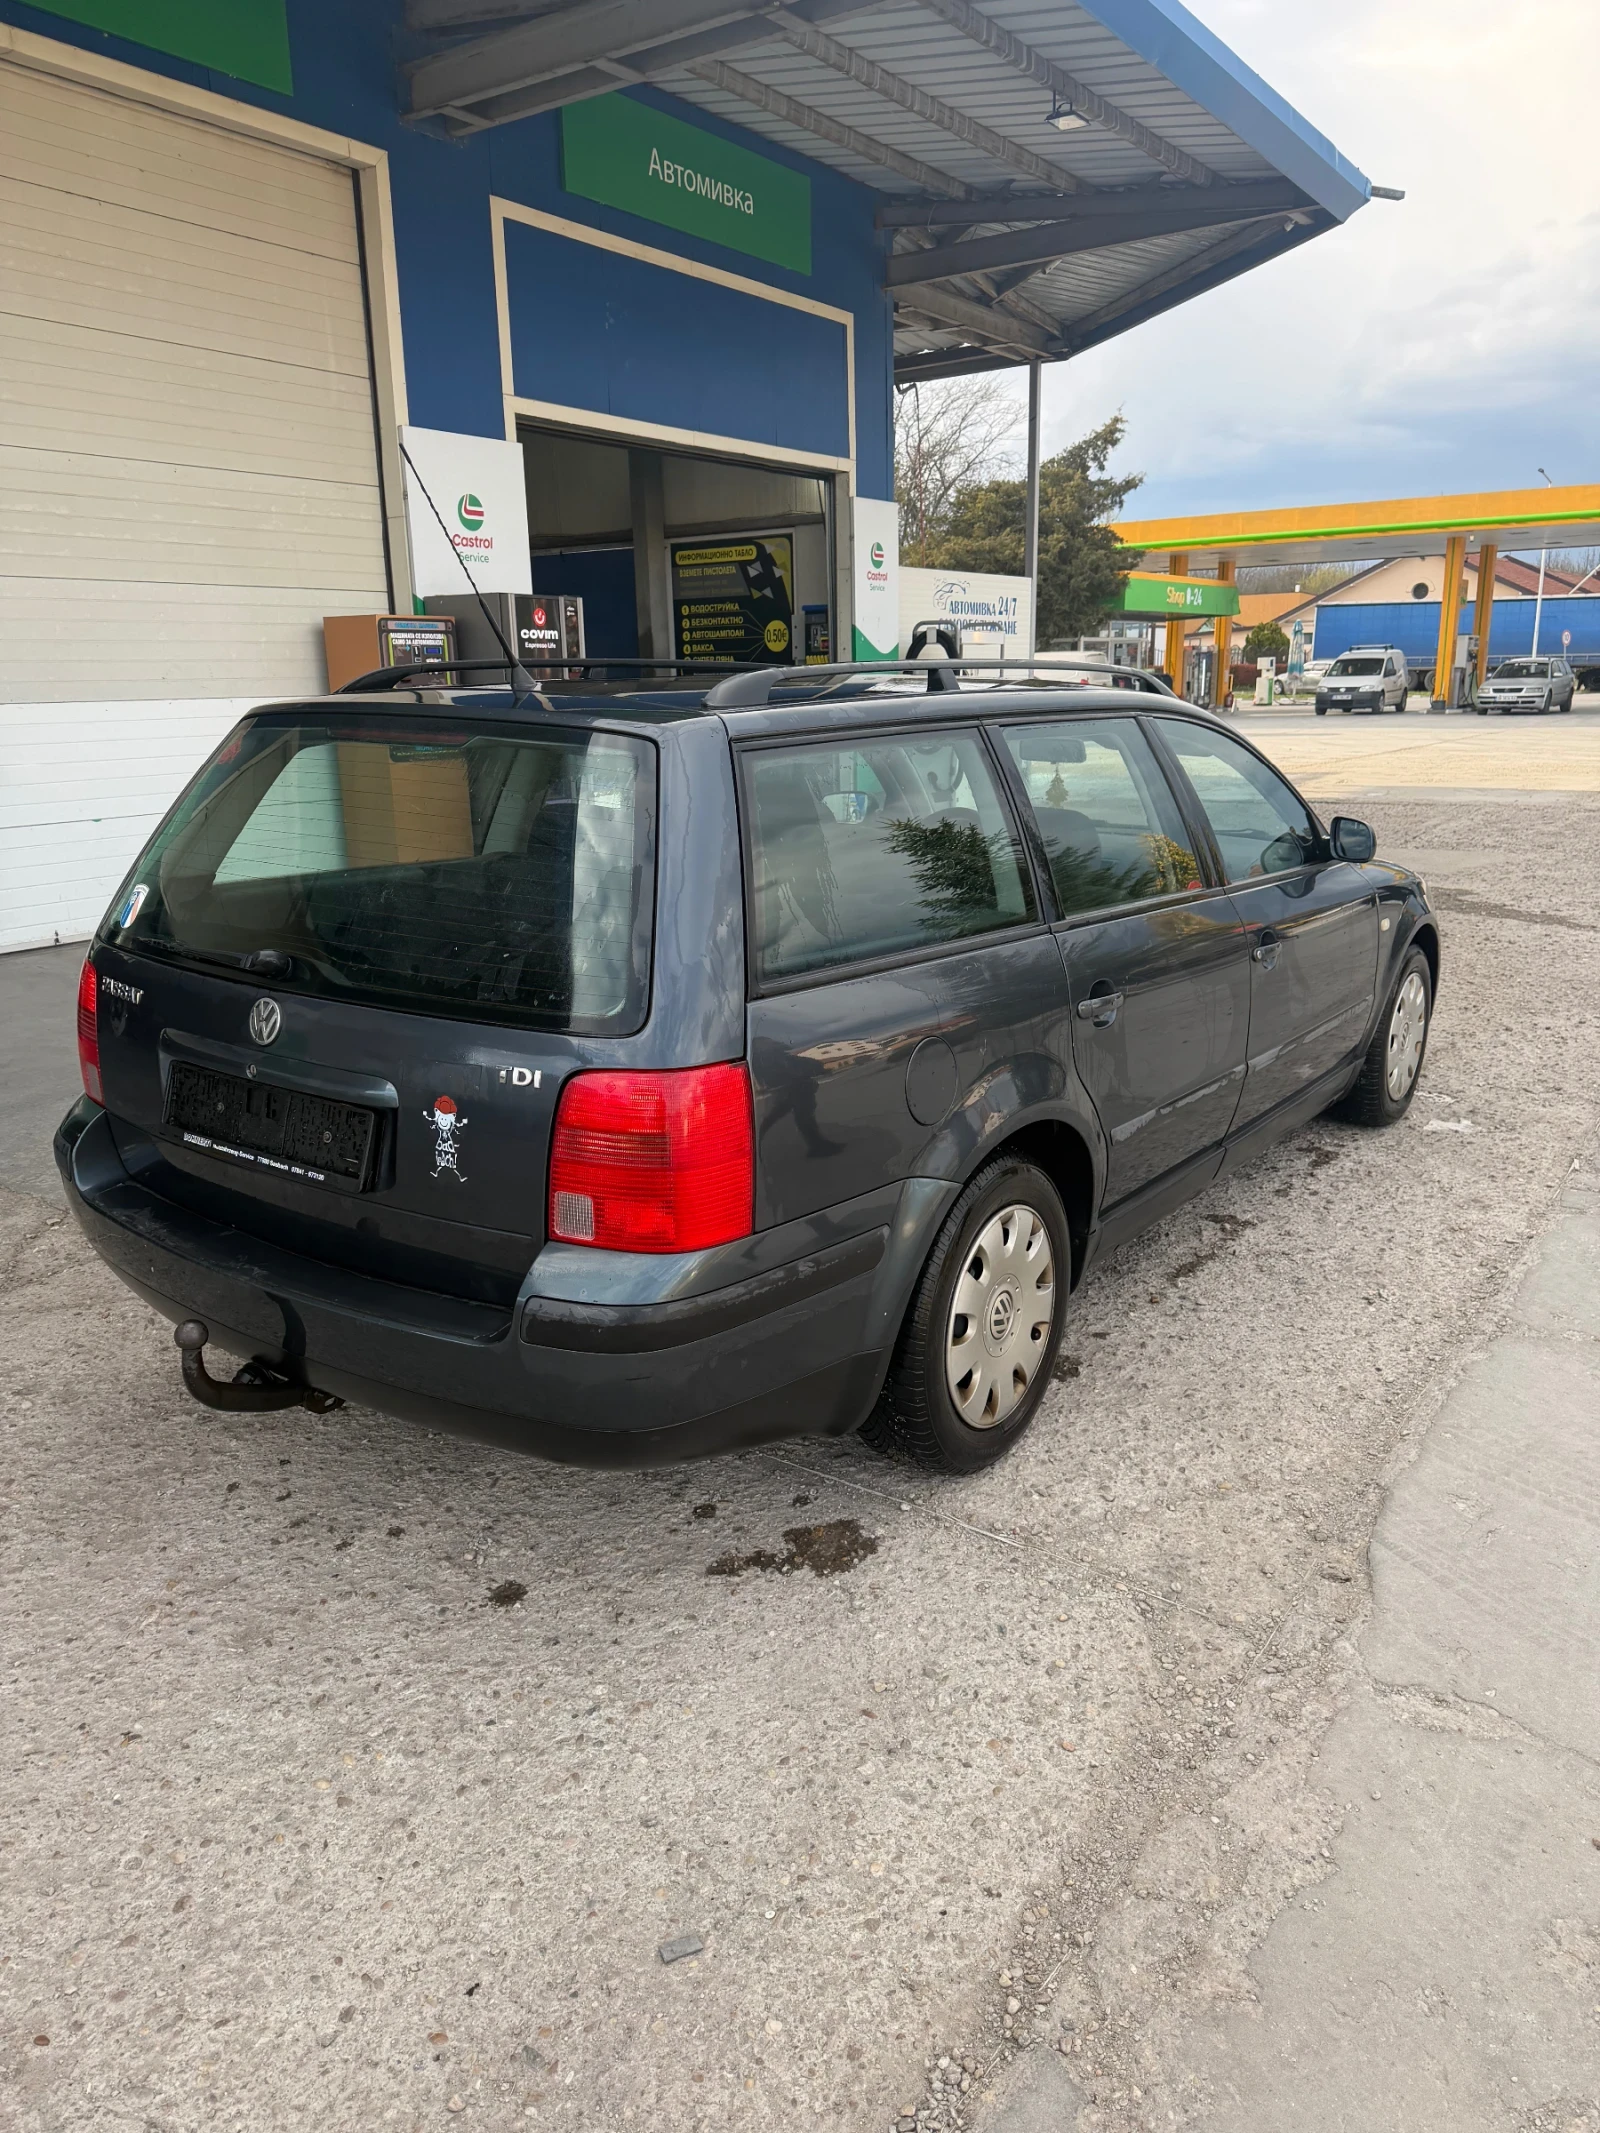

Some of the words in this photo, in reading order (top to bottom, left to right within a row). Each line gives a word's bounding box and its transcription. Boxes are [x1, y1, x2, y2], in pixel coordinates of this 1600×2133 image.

[648, 147, 754, 215] Автомивка
[452, 533, 494, 549] Castrol
[459, 551, 490, 563] Service
[678, 549, 734, 562] ИНФОРМАЦИОННО
[734, 547, 754, 558] ТАБЛО
[703, 565, 737, 576] ПИСТОЛЕТА
[867, 571, 888, 582] Castrol
[869, 583, 886, 592] Service
[690, 602, 740, 613] ВОДОСТРУЙКА
[949, 600, 996, 617] АВТОМИВКА
[998, 596, 1018, 619] 24/7
[691, 616, 744, 626] БЕЗКОНТАКТНО
[520, 629, 559, 640] covim
[691, 629, 745, 639] АВТОШАМПОАН
[766, 628, 788, 643] 0.50€
[692, 644, 715, 652] ВАКСА
[101, 975, 145, 1004] PASSAT
[495, 1064, 542, 1089] TDI
